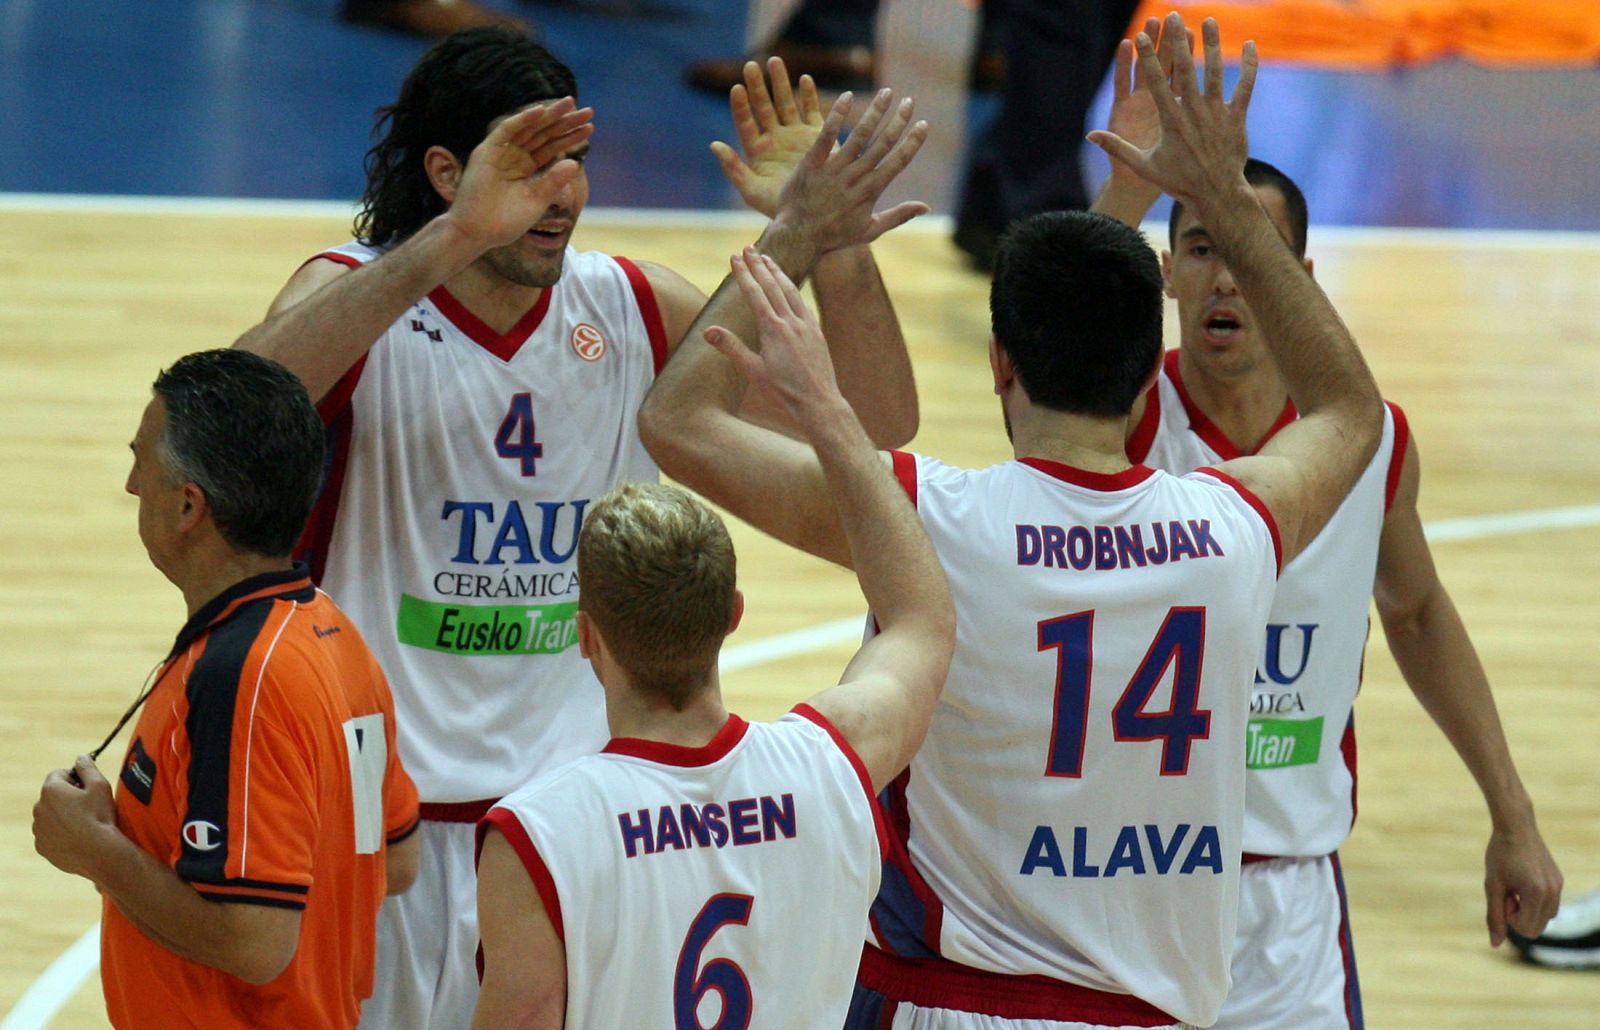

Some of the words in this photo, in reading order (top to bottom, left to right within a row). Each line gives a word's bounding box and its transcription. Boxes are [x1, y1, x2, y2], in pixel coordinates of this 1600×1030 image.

[494, 392, 543, 477] 4
[440, 500, 590, 565] TAU
[1015, 519, 1224, 571] DROBNJAK
[1037, 606, 1212, 779] 14
[617, 793, 797, 859] HANSEN
[1019, 823, 1224, 878] ALAVA
[673, 891, 755, 1030] 6
